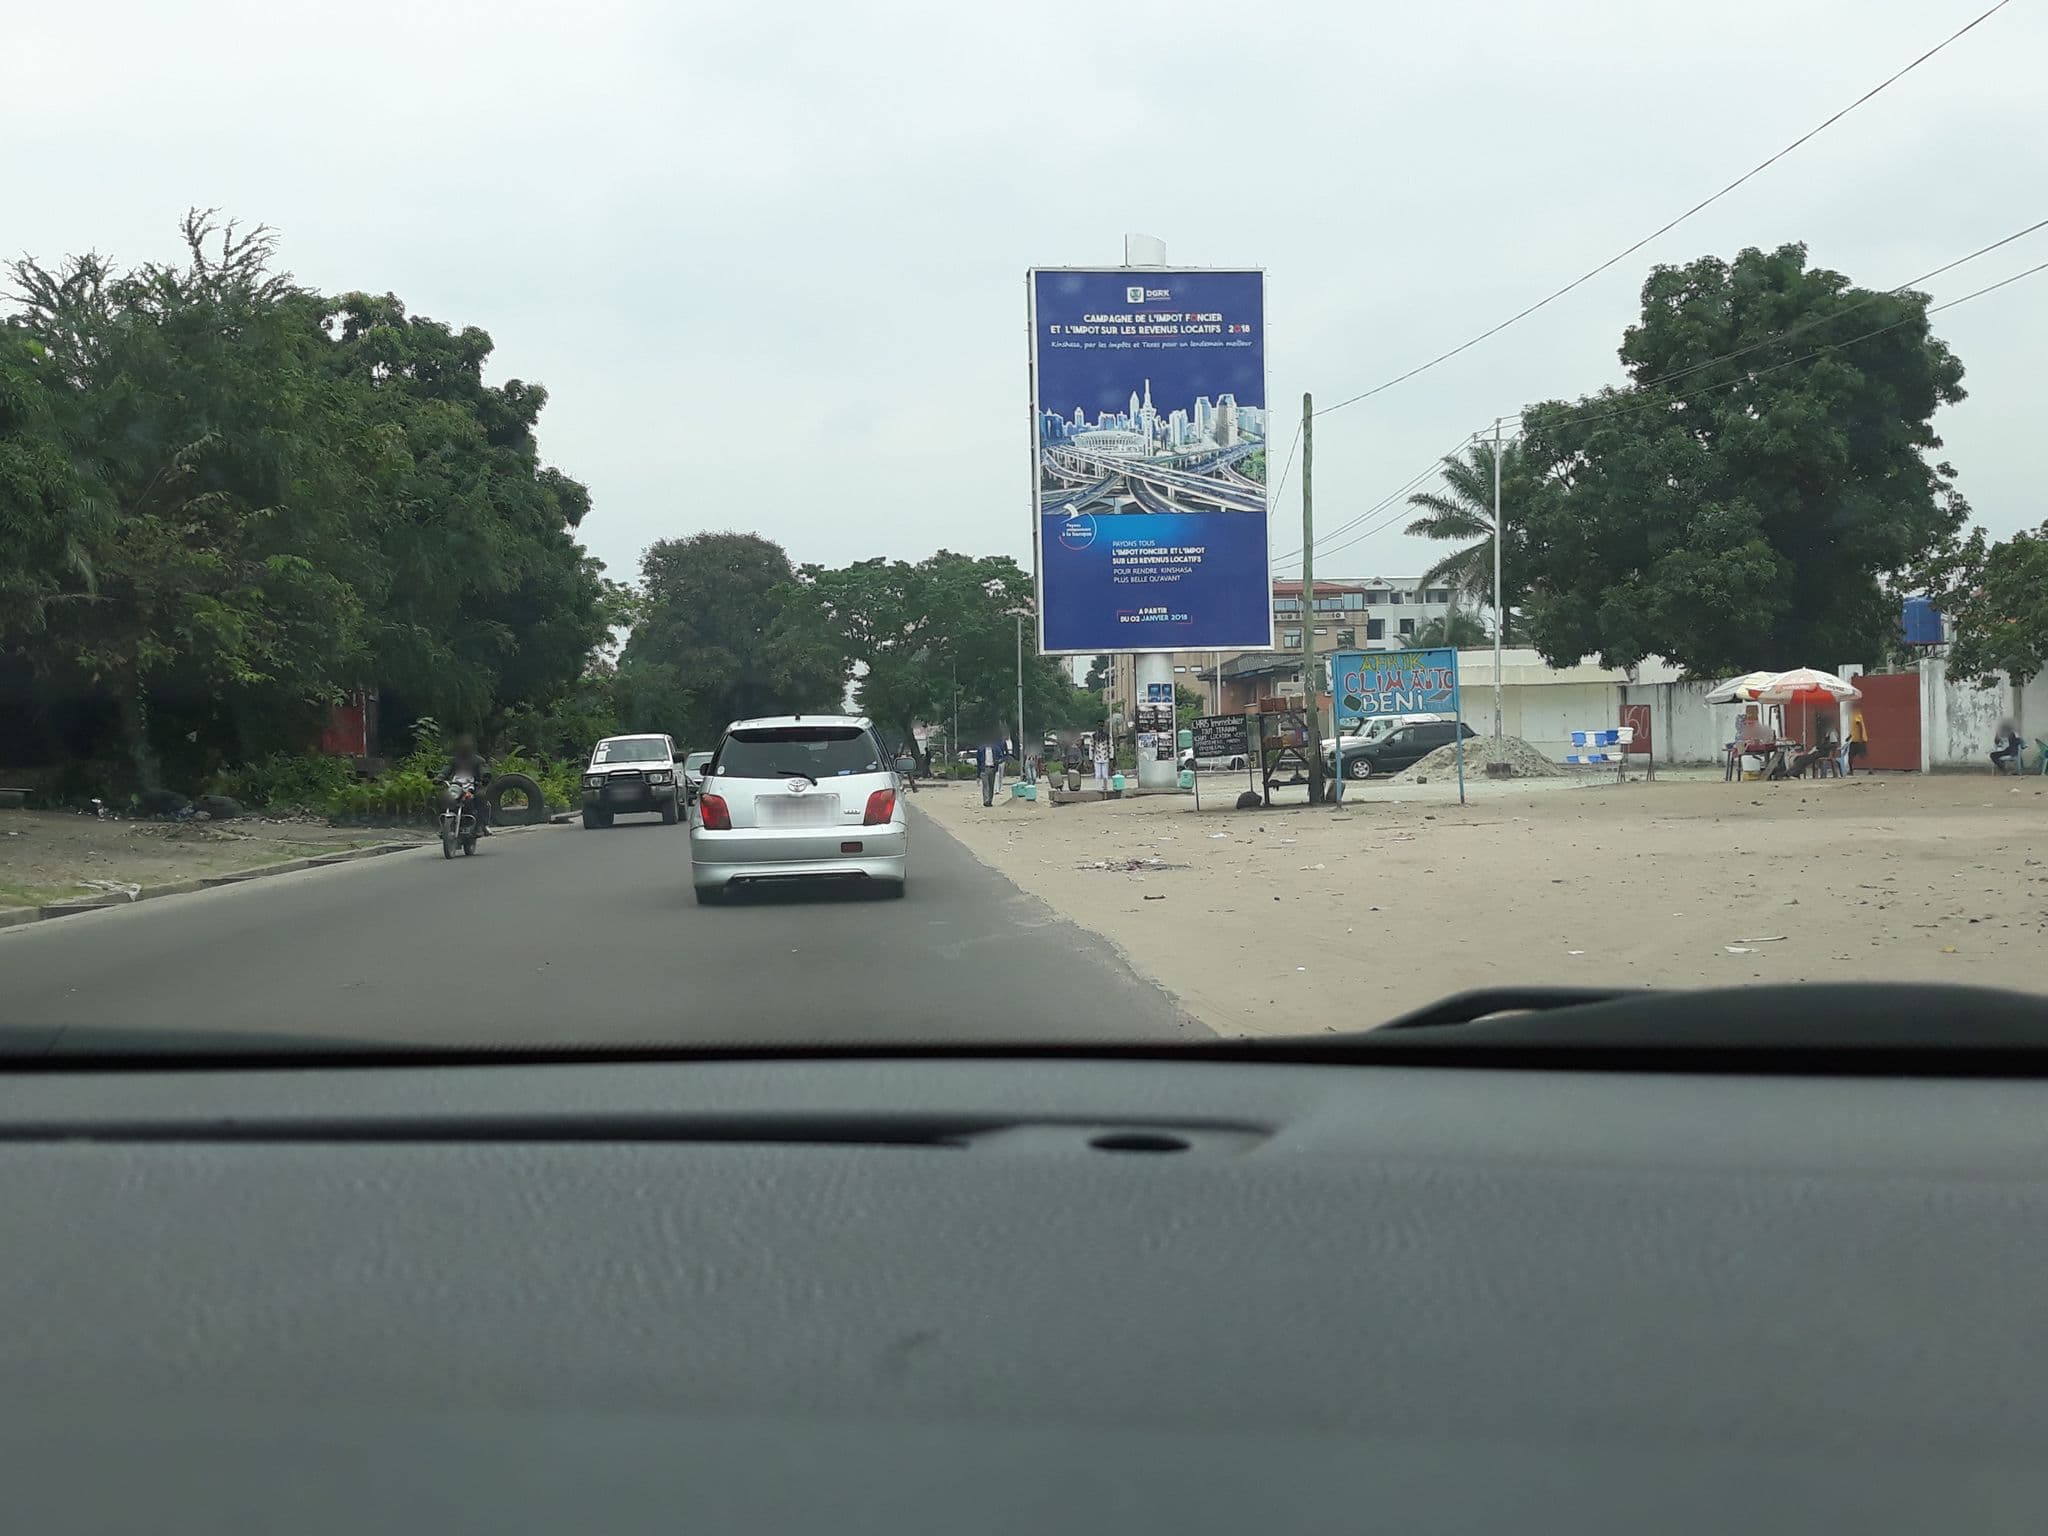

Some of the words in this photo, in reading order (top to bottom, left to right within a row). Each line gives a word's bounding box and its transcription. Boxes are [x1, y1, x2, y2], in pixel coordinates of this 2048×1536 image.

[1083, 314, 1133, 323] CAMPAGNE
[1135, 314, 1146, 323] DE
[1148, 314, 1182, 322] L'IMPOT
[1185, 313, 1223, 322] FONCIER
[1050, 325, 1061, 334] ET
[1065, 325, 1099, 334] L'IMPOT
[1101, 325, 1118, 334] SUR
[1120, 325, 1136, 335] LES
[1138, 325, 1178, 334] REVENUS
[1180, 325, 1221, 334] LOCATIFS
[1228, 324, 1250, 333] 2018
[1113, 575, 1129, 583] PLUS
[1361, 651, 1425, 672] AFRIK
